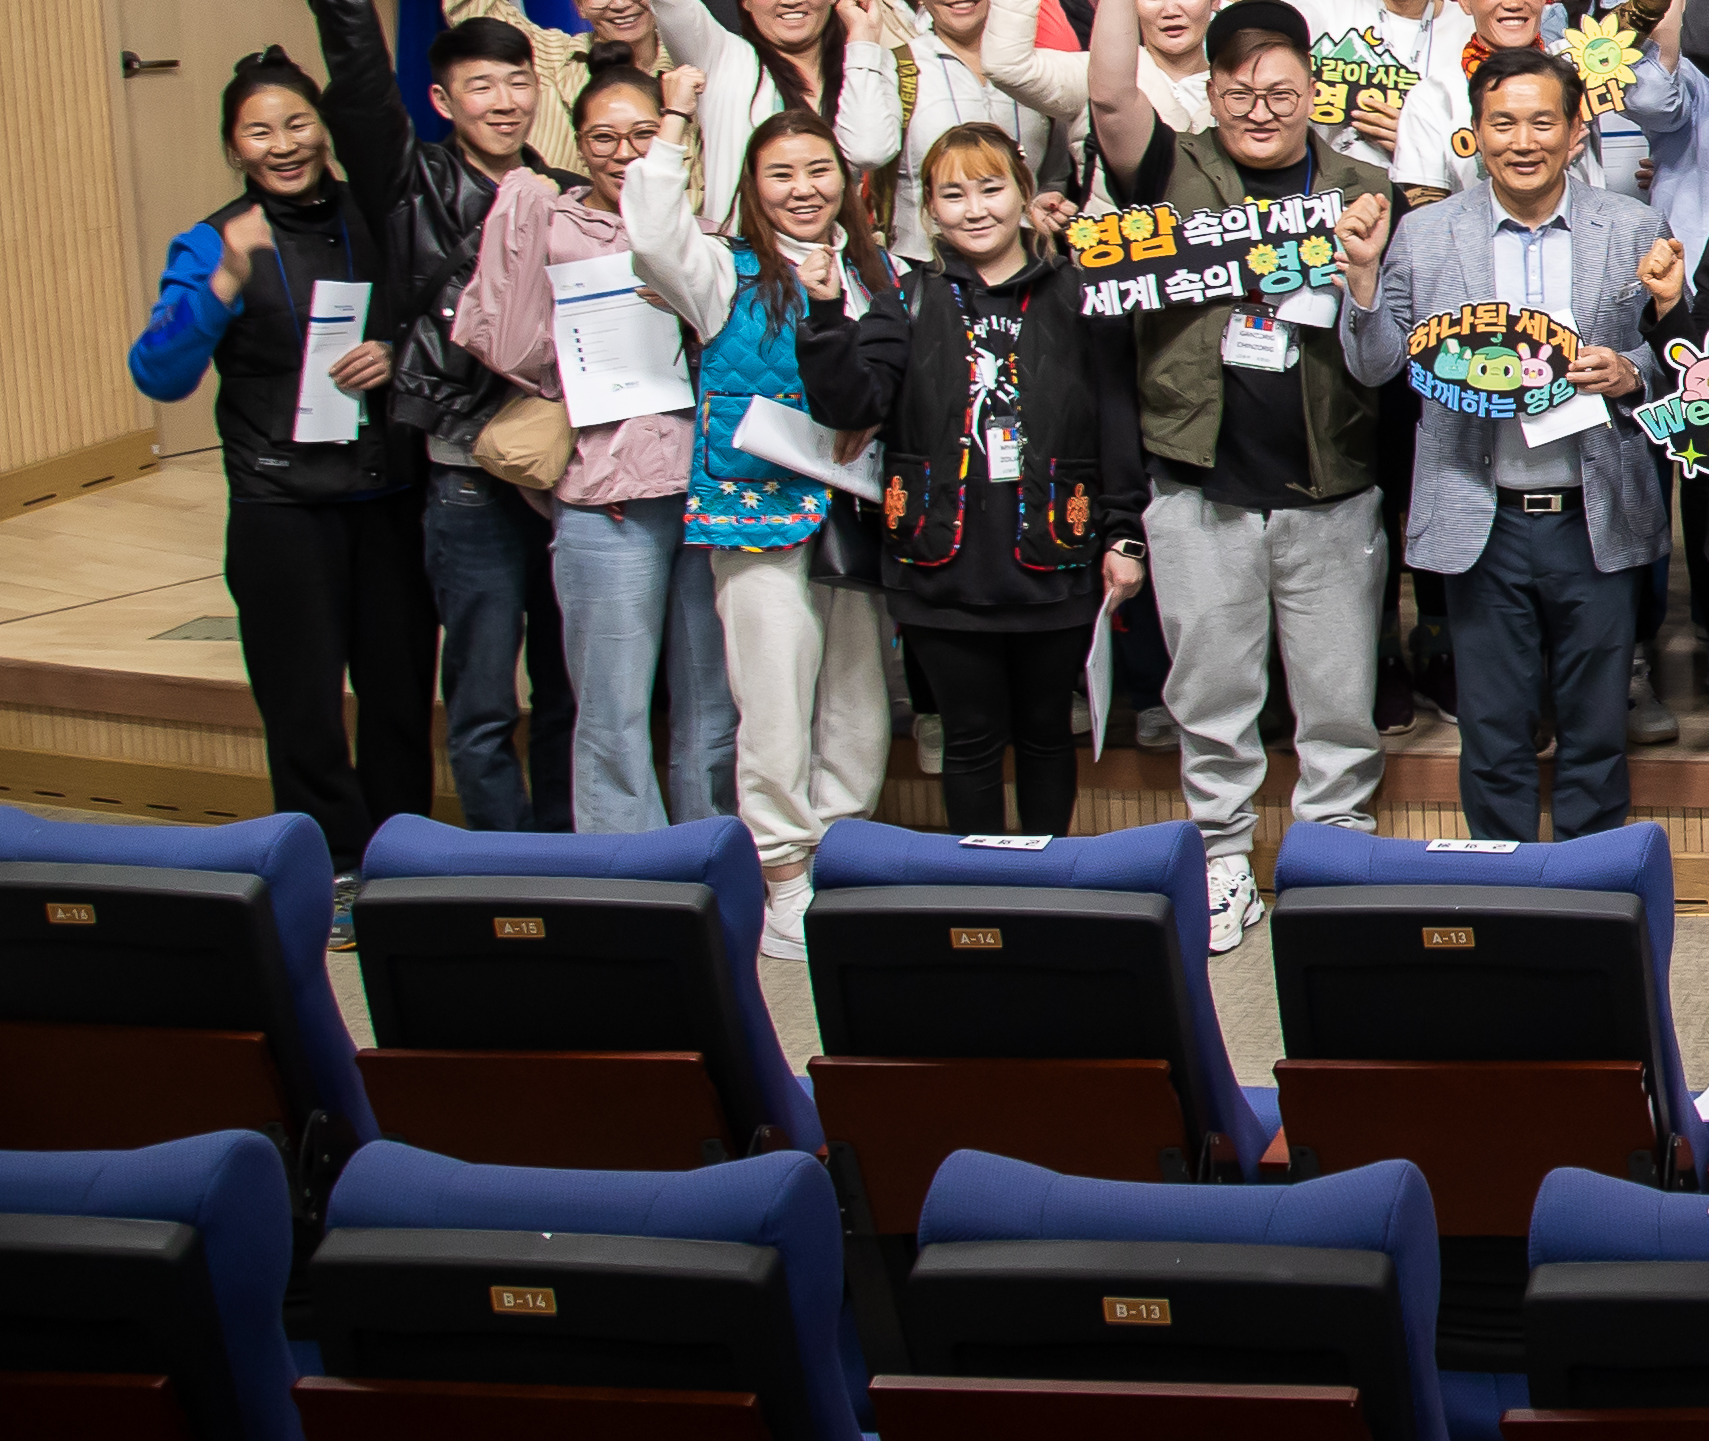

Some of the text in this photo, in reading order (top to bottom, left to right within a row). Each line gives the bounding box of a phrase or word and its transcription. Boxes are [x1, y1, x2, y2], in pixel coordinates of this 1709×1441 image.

[1183, 203, 1262, 247] 속의
[1267, 191, 1344, 235] 세계
[1081, 273, 1164, 317] 세계
[1164, 260, 1247, 303] 속의
[1409, 304, 1579, 364] 하나된 세계
[1409, 360, 1517, 418] 함께하는
[504, 922, 537, 934] A-15
[1432, 932, 1467, 944] A-13
[503, 1292, 547, 1309] B-14
[1115, 1303, 1160, 1319] B-13
